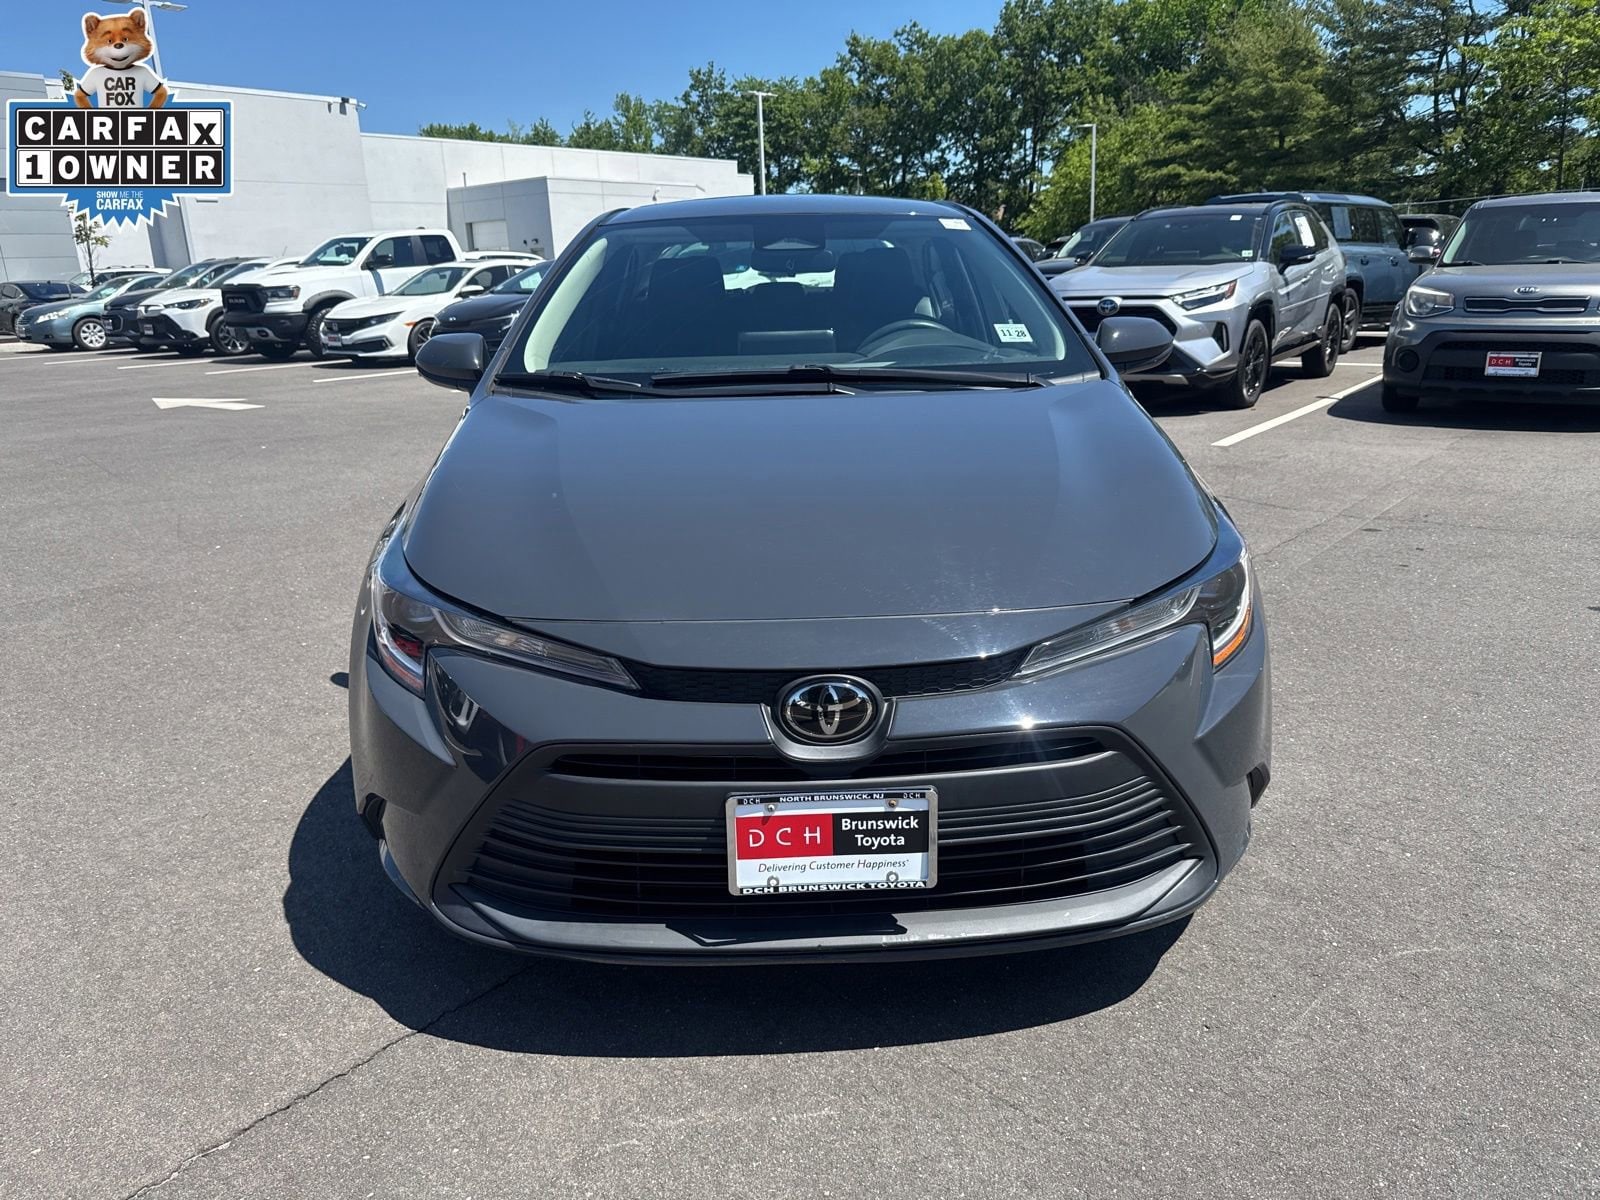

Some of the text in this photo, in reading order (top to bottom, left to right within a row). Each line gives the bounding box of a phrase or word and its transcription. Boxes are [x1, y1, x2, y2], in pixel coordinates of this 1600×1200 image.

[780, 794, 812, 803] NORTH
[841, 816, 919, 831] Brunswick
[855, 834, 905, 850] Toyota
[758, 863, 807, 873] Delivering
[809, 860, 856, 871] Customer
[742, 881, 926, 895] DCH BRUNSWICK TOYOTA
